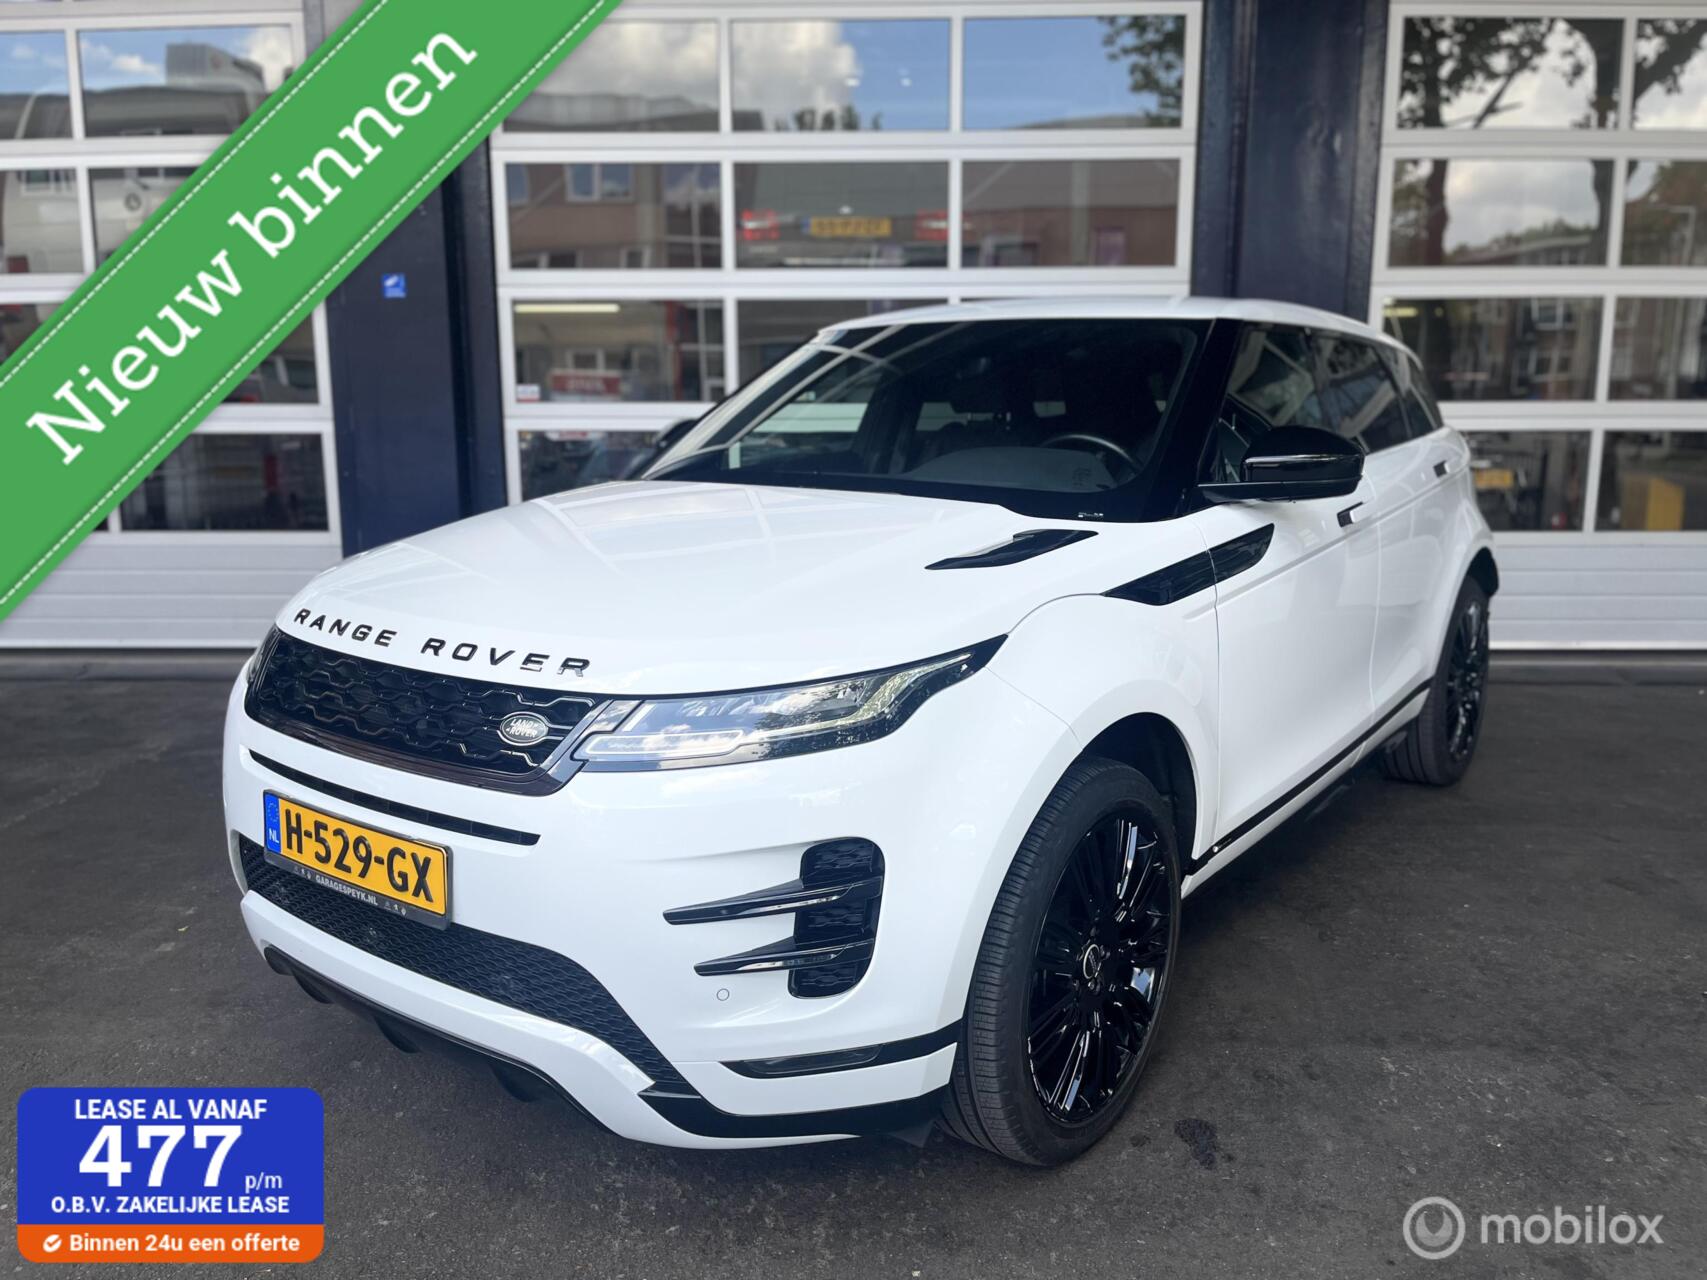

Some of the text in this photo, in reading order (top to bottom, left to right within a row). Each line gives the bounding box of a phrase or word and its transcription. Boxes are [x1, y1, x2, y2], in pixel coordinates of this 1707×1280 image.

[293, 608, 590, 677] RANGE ROVER
[509, 726, 538, 737] ROVER
[510, 719, 534, 727] LAND
[268, 828, 280, 844] NL
[285, 808, 434, 903] H-529-GX
[315, 874, 379, 906] GARAGESPEYK.NL
